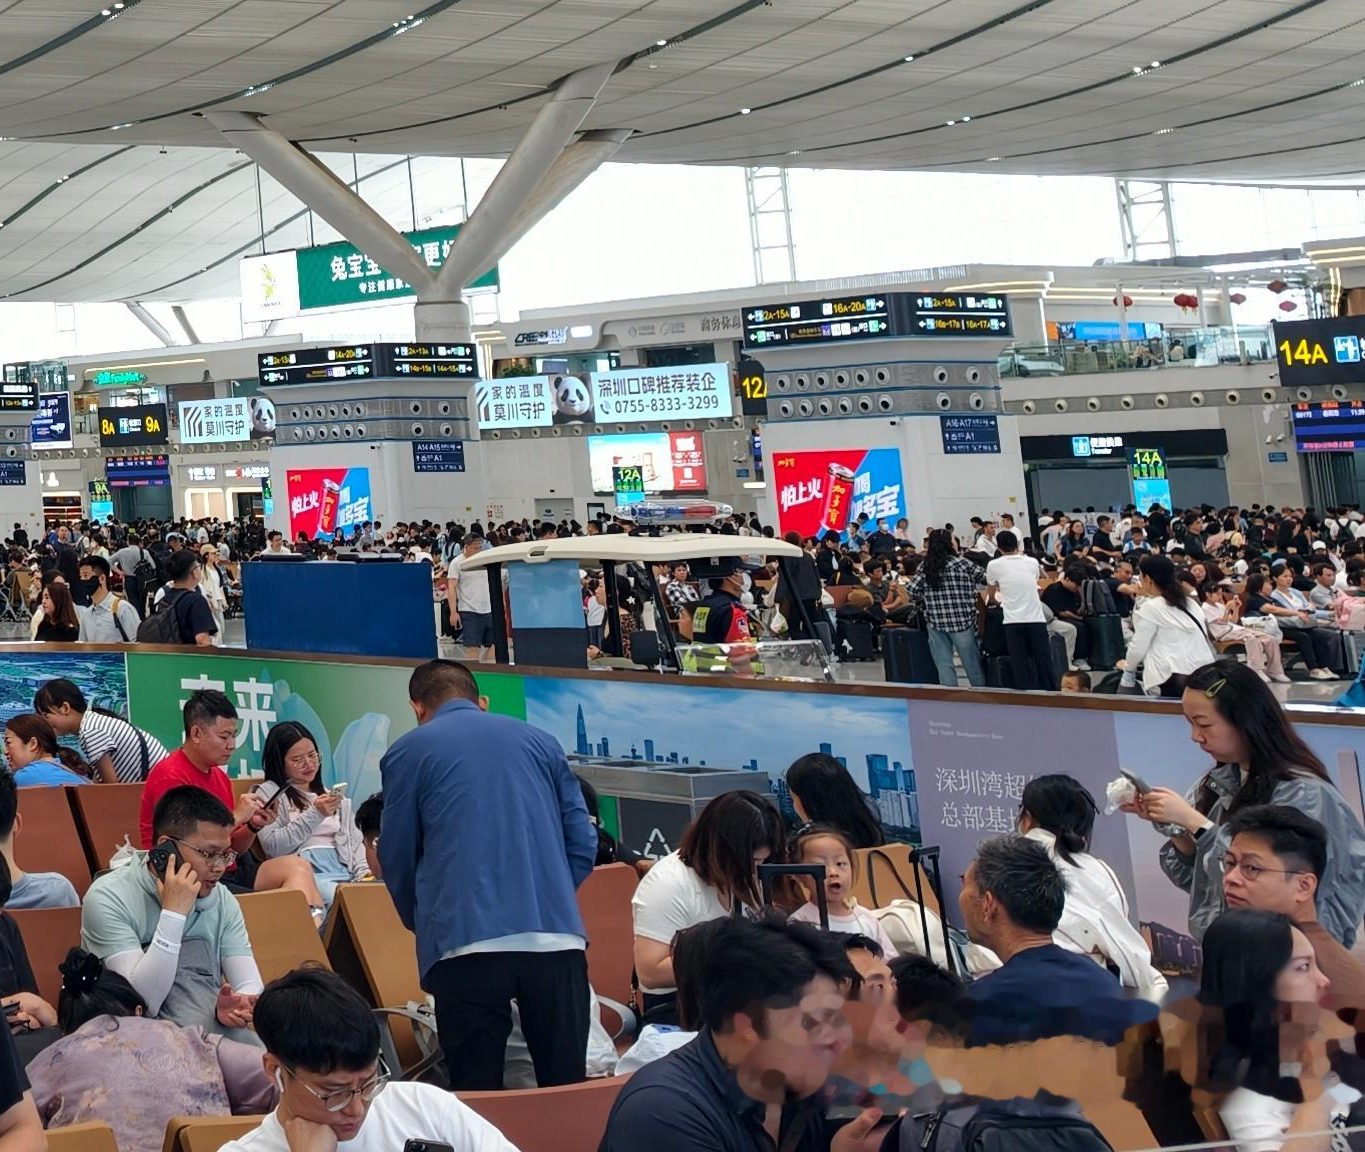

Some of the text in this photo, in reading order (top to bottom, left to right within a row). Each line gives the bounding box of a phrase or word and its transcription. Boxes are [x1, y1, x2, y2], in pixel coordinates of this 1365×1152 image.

[763, 301, 867, 321] 2A-15A 16A-20A
[1279, 338, 1329, 366] 14A
[491, 382, 545, 400] 家的温度
[598, 371, 717, 398] 深圳口碑推荐装企
[742, 375, 767, 399] 12
[203, 403, 245, 419] 家的温度
[493, 400, 546, 422] 莫川守护
[614, 394, 720, 415] 0755-8333-3299
[101, 416, 161, 435] 8A 9A
[205, 419, 246, 437] 莫川守护
[1133, 450, 1163, 465] 14A
[618, 468, 641, 481] 12A
[290, 490, 320, 519] 怕上火
[780, 477, 824, 513] 怕上火
[935, 767, 1038, 801] 深圳湾超
